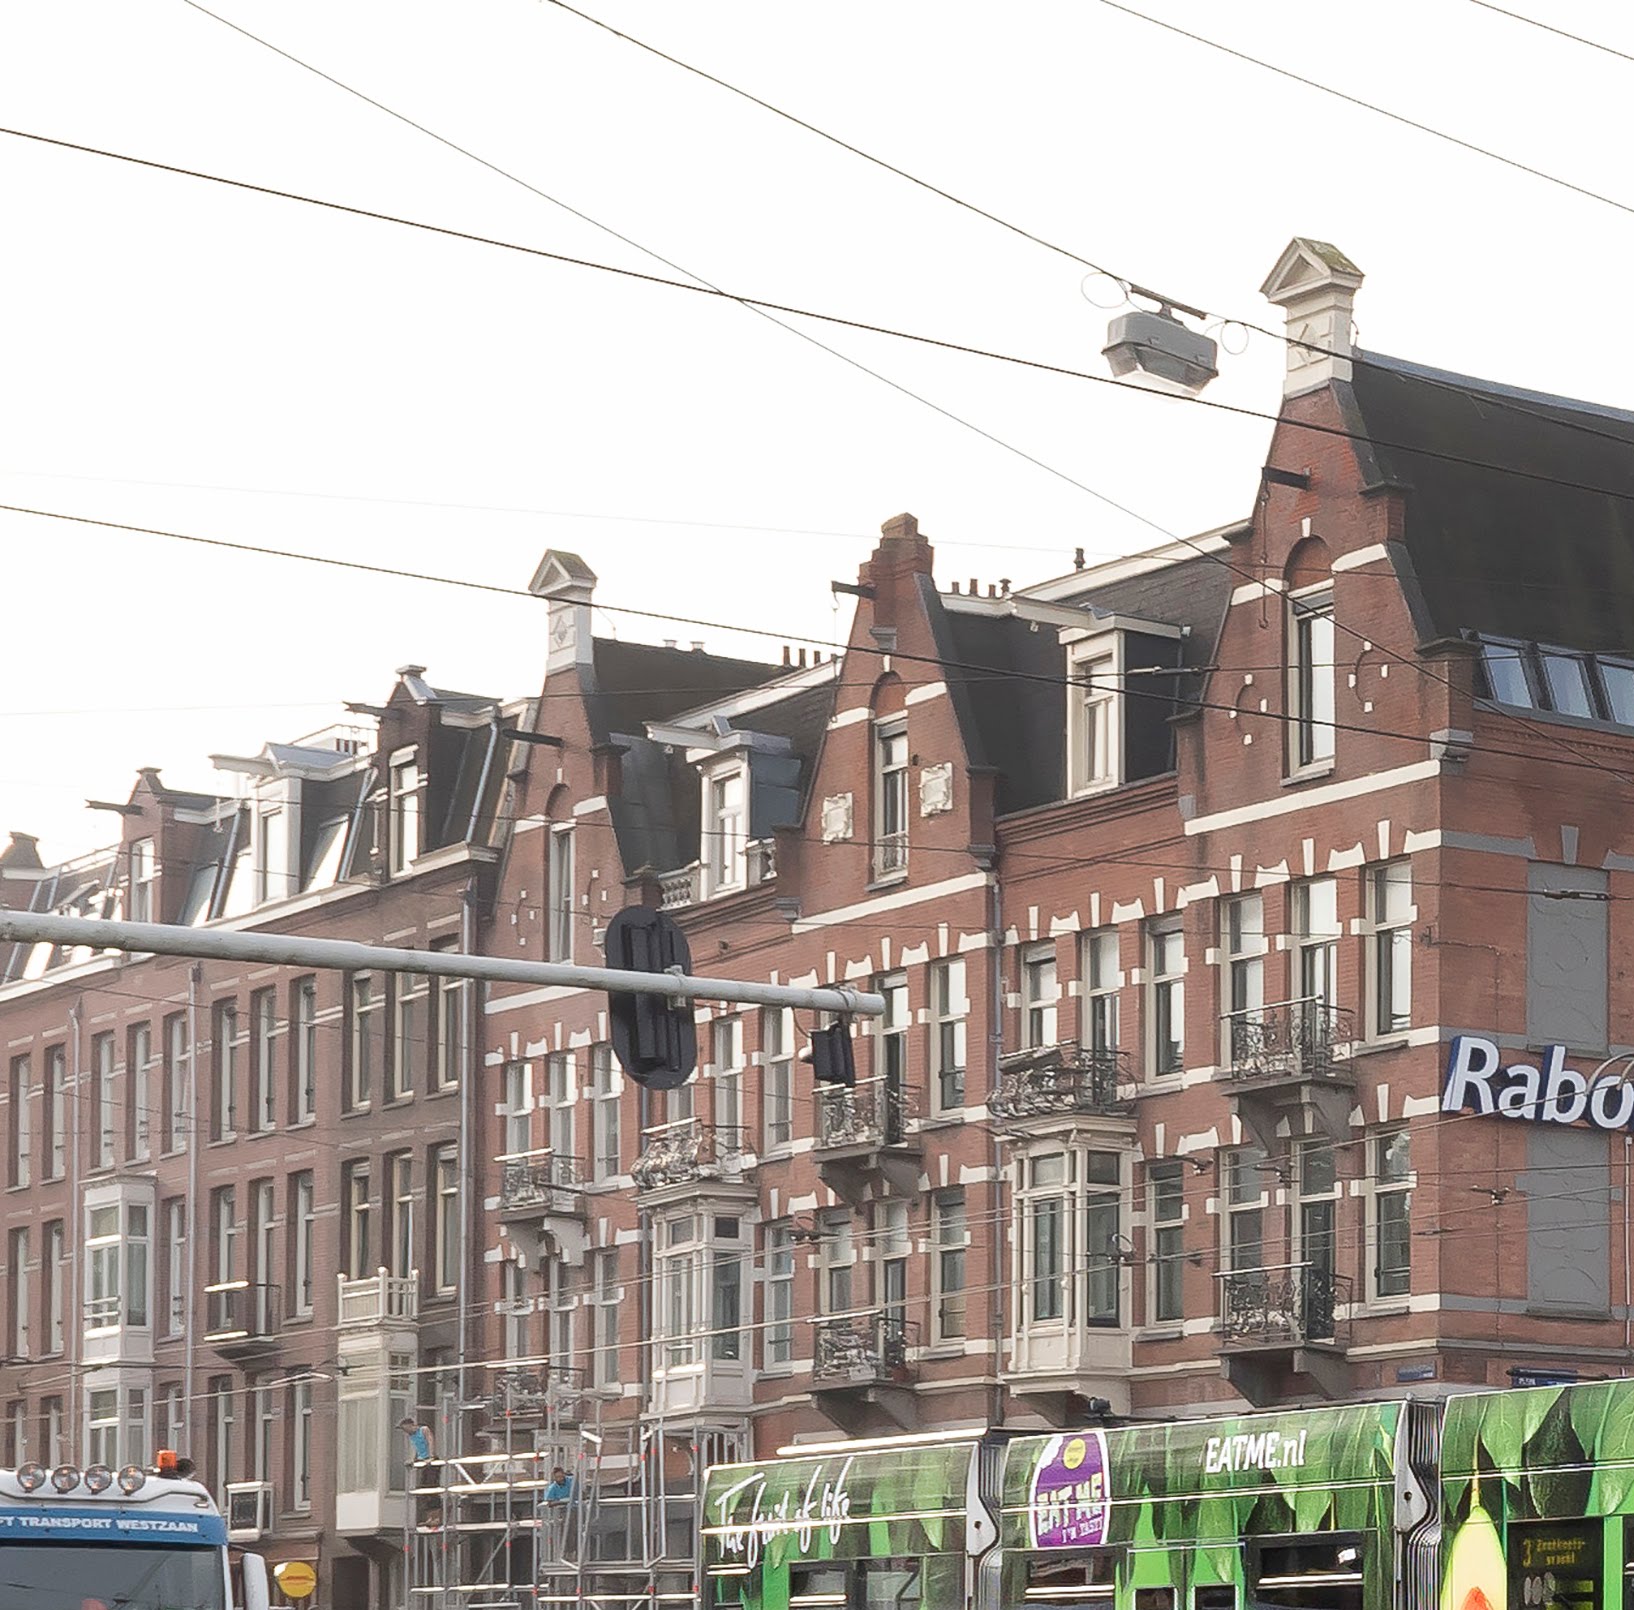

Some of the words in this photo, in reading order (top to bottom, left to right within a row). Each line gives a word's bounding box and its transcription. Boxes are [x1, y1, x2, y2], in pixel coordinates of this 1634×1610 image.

[1205, 1429, 1307, 1473] EATME.nl
[17, 1516, 113, 1529] TRANSPORT
[117, 1519, 199, 1533] WESTZAAN
[714, 1472, 765, 1558] The
